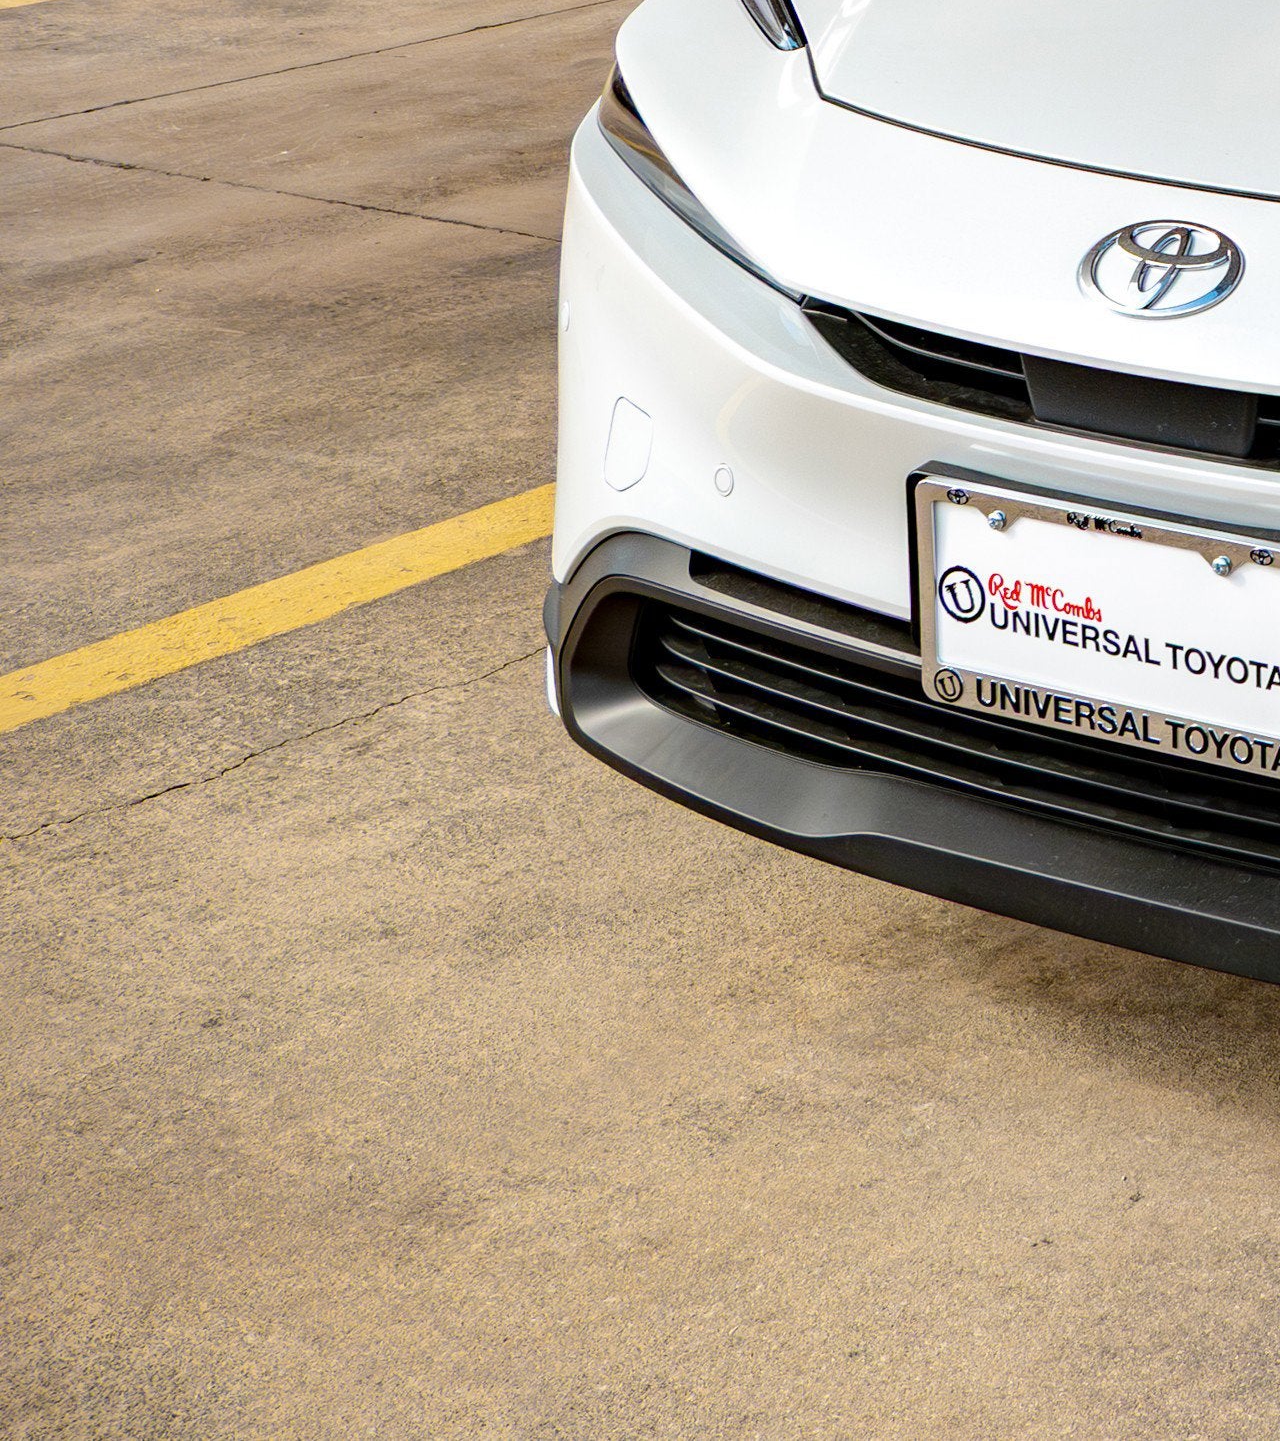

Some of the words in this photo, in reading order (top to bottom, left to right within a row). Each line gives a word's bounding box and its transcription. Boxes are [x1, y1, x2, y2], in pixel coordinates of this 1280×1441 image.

[988, 573, 1022, 611] Red
[1025, 580, 1103, 623] McCombs
[990, 603, 1161, 666] UNIVERSAL
[976, 677, 1161, 744] UNIVERSAL
